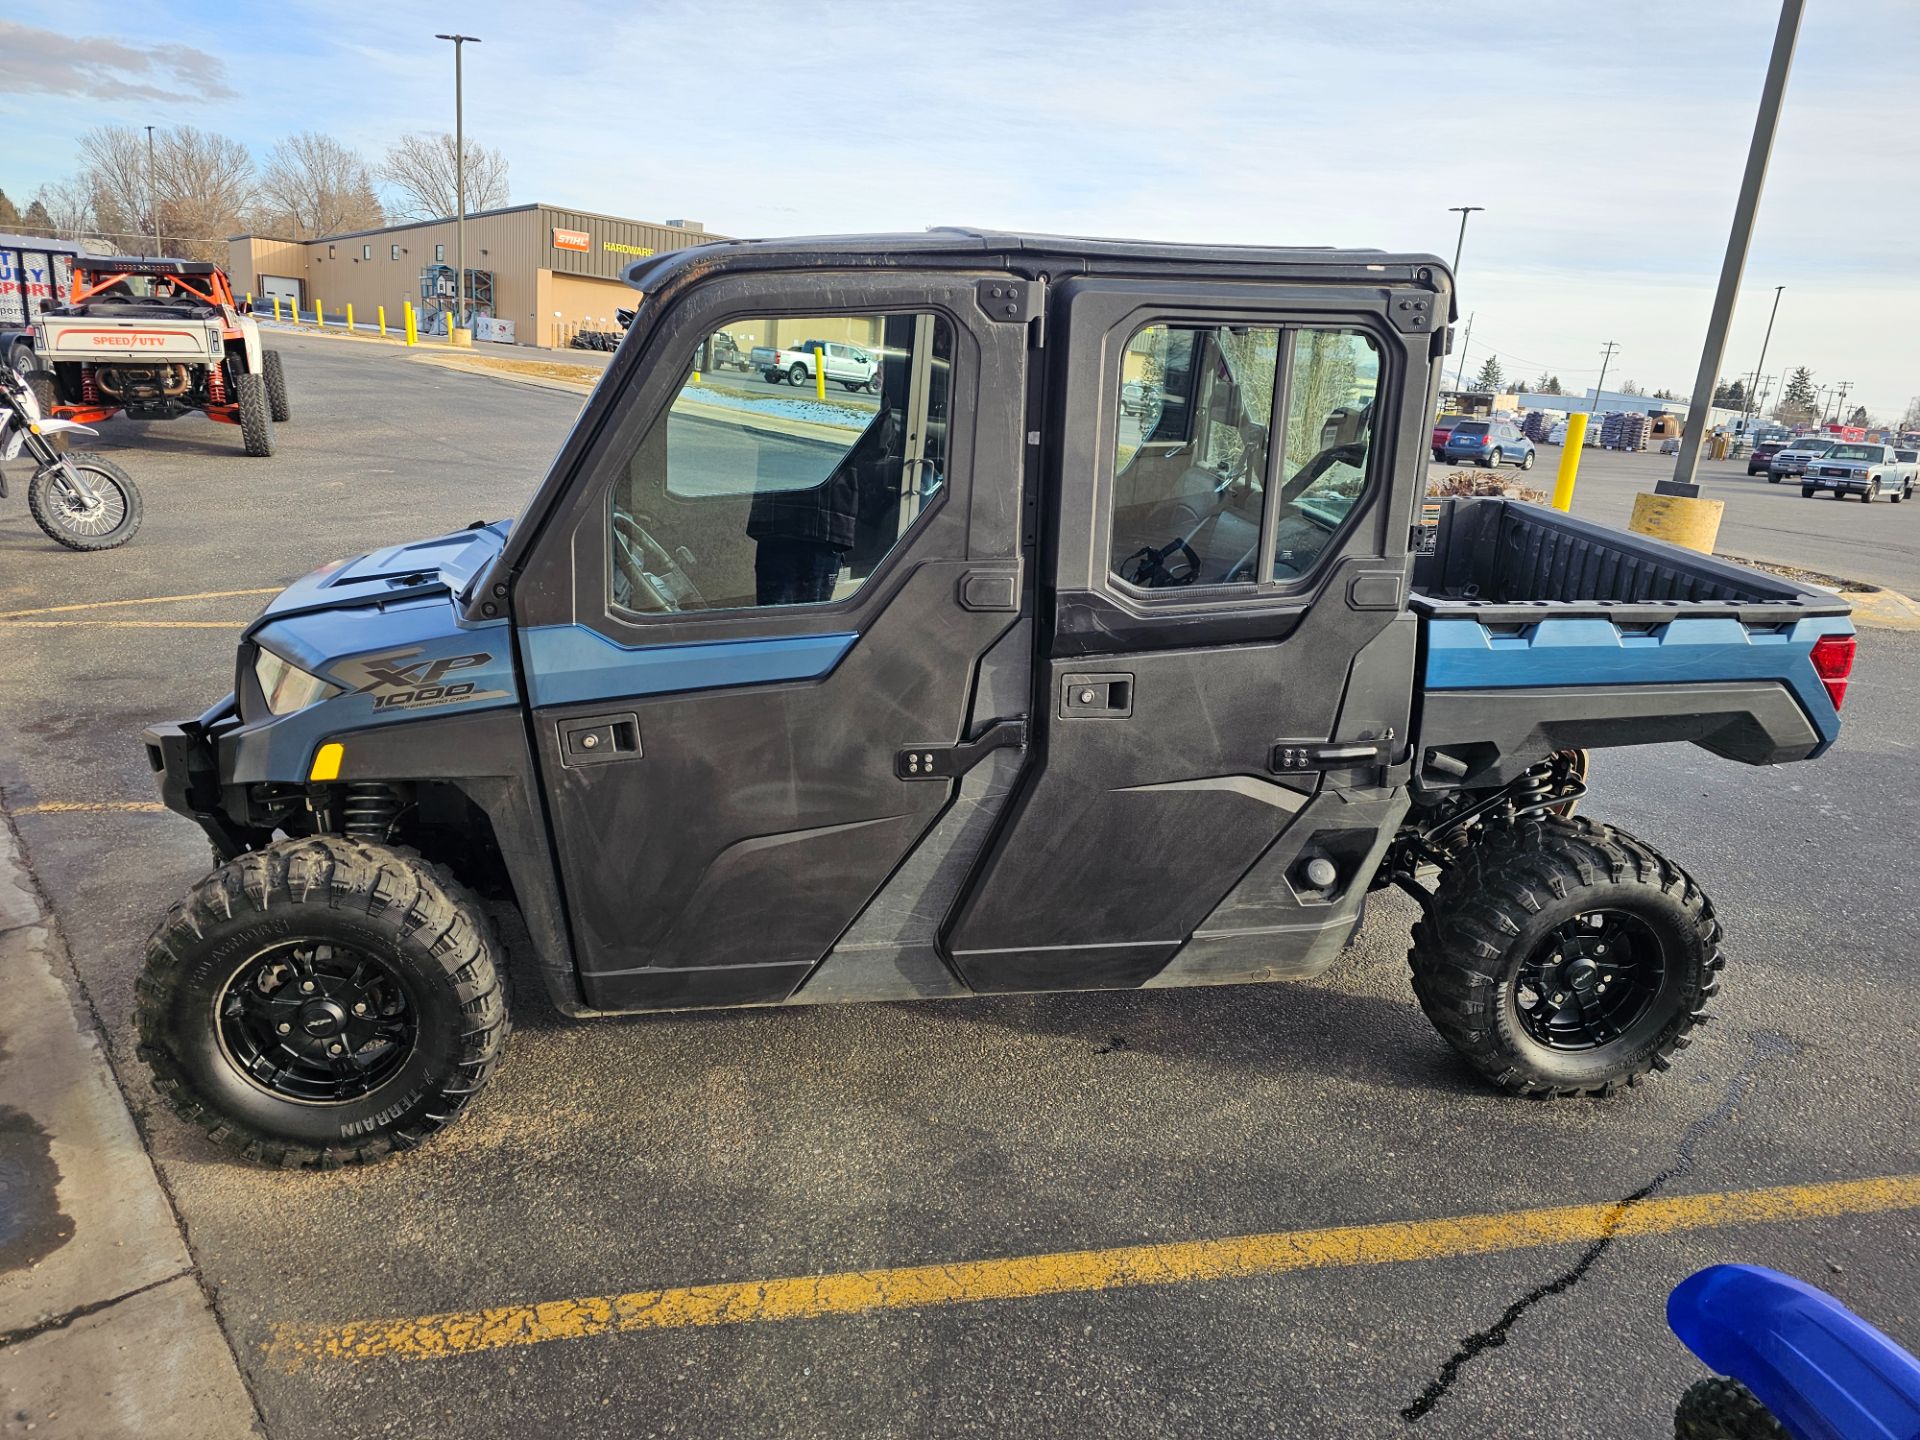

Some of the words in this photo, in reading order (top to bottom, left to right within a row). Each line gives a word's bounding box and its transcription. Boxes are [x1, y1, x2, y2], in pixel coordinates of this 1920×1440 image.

[558, 235, 587, 246] STIHL
[603, 241, 655, 257] HARDWARE
[93, 336, 130, 346] SPEED
[140, 337, 165, 346] UTV
[346, 652, 494, 696] XP
[374, 682, 475, 708] 1000
